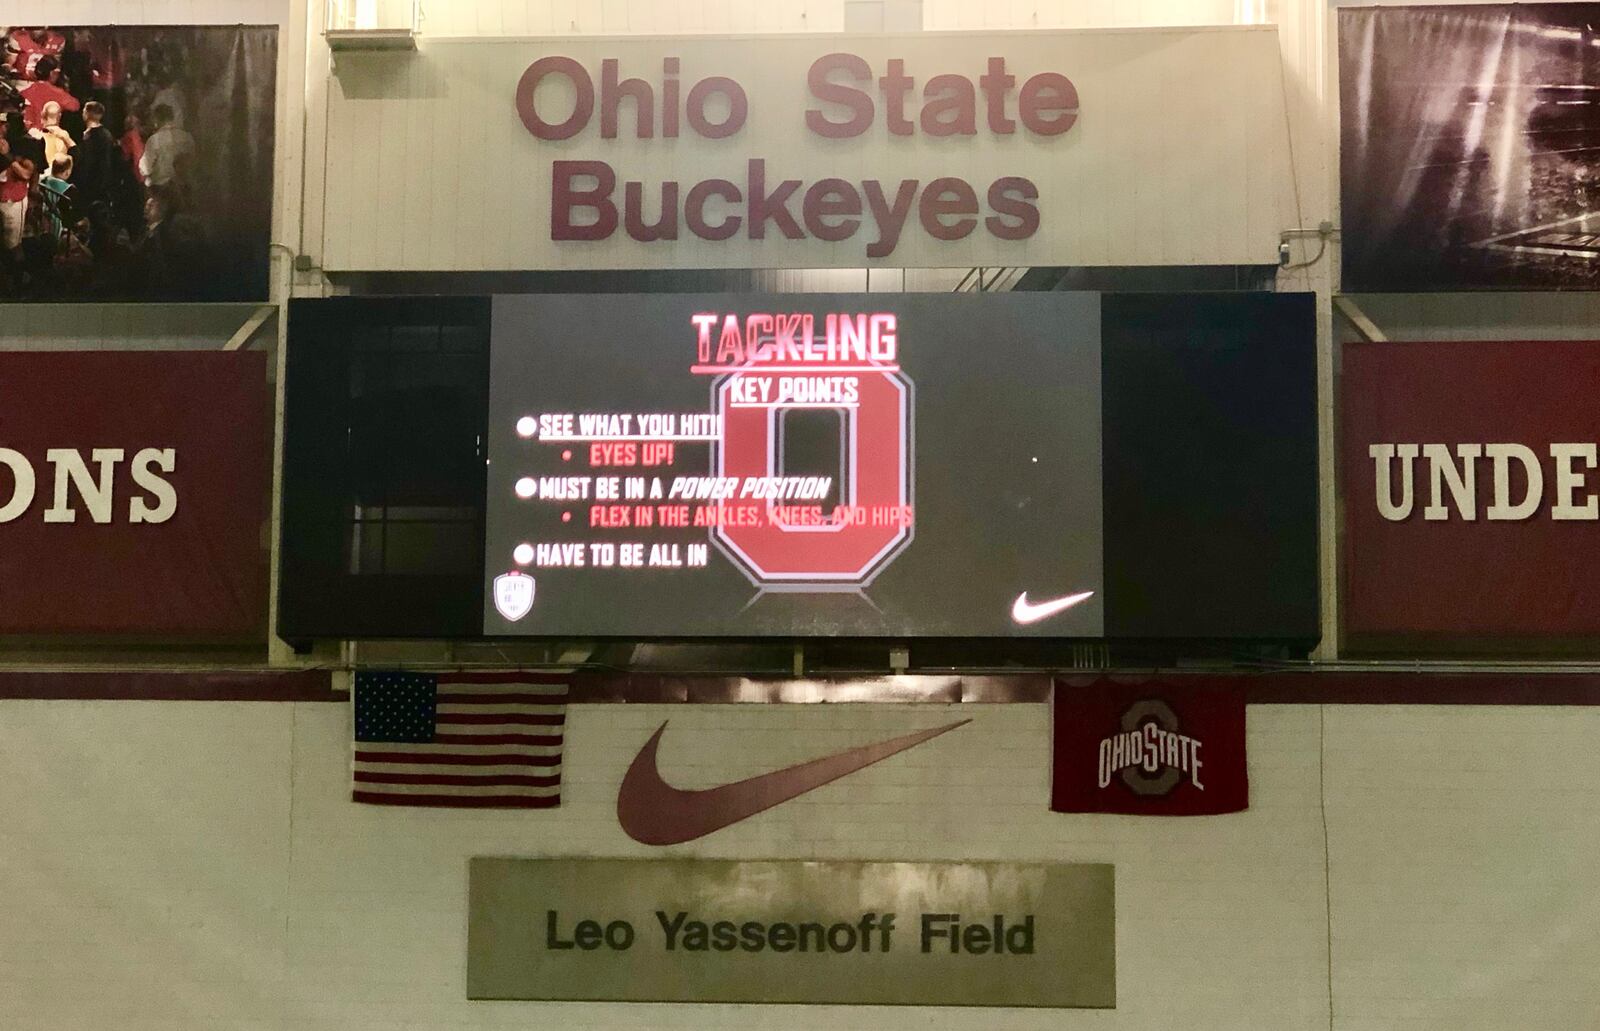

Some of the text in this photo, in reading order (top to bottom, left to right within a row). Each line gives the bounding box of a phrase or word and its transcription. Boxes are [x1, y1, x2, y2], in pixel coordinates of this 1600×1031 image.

[515, 52, 1080, 141] Ohio State
[550, 158, 1041, 258] Buckeyes
[692, 313, 897, 363] TACKLING
[730, 377, 859, 402] KEY POINTS
[539, 414, 574, 436] SEE
[579, 414, 632, 436] WHAT
[637, 414, 675, 436] YOU
[590, 444, 674, 466] EYES UP!
[539, 477, 832, 500] MUST BE IN A POWER POSITION
[1369, 443, 1599, 521] UNDE
[590, 506, 631, 528] FLEX
[634, 506, 654, 527] IN
[657, 506, 690, 527] THE
[693, 506, 763, 529] ANKLES,
[832, 505, 867, 527] AND
[871, 505, 913, 527] HIPS
[537, 543, 707, 567] HAVE TO BE ALL IN
[546, 910, 1035, 955] Leo Yassenoff Field
